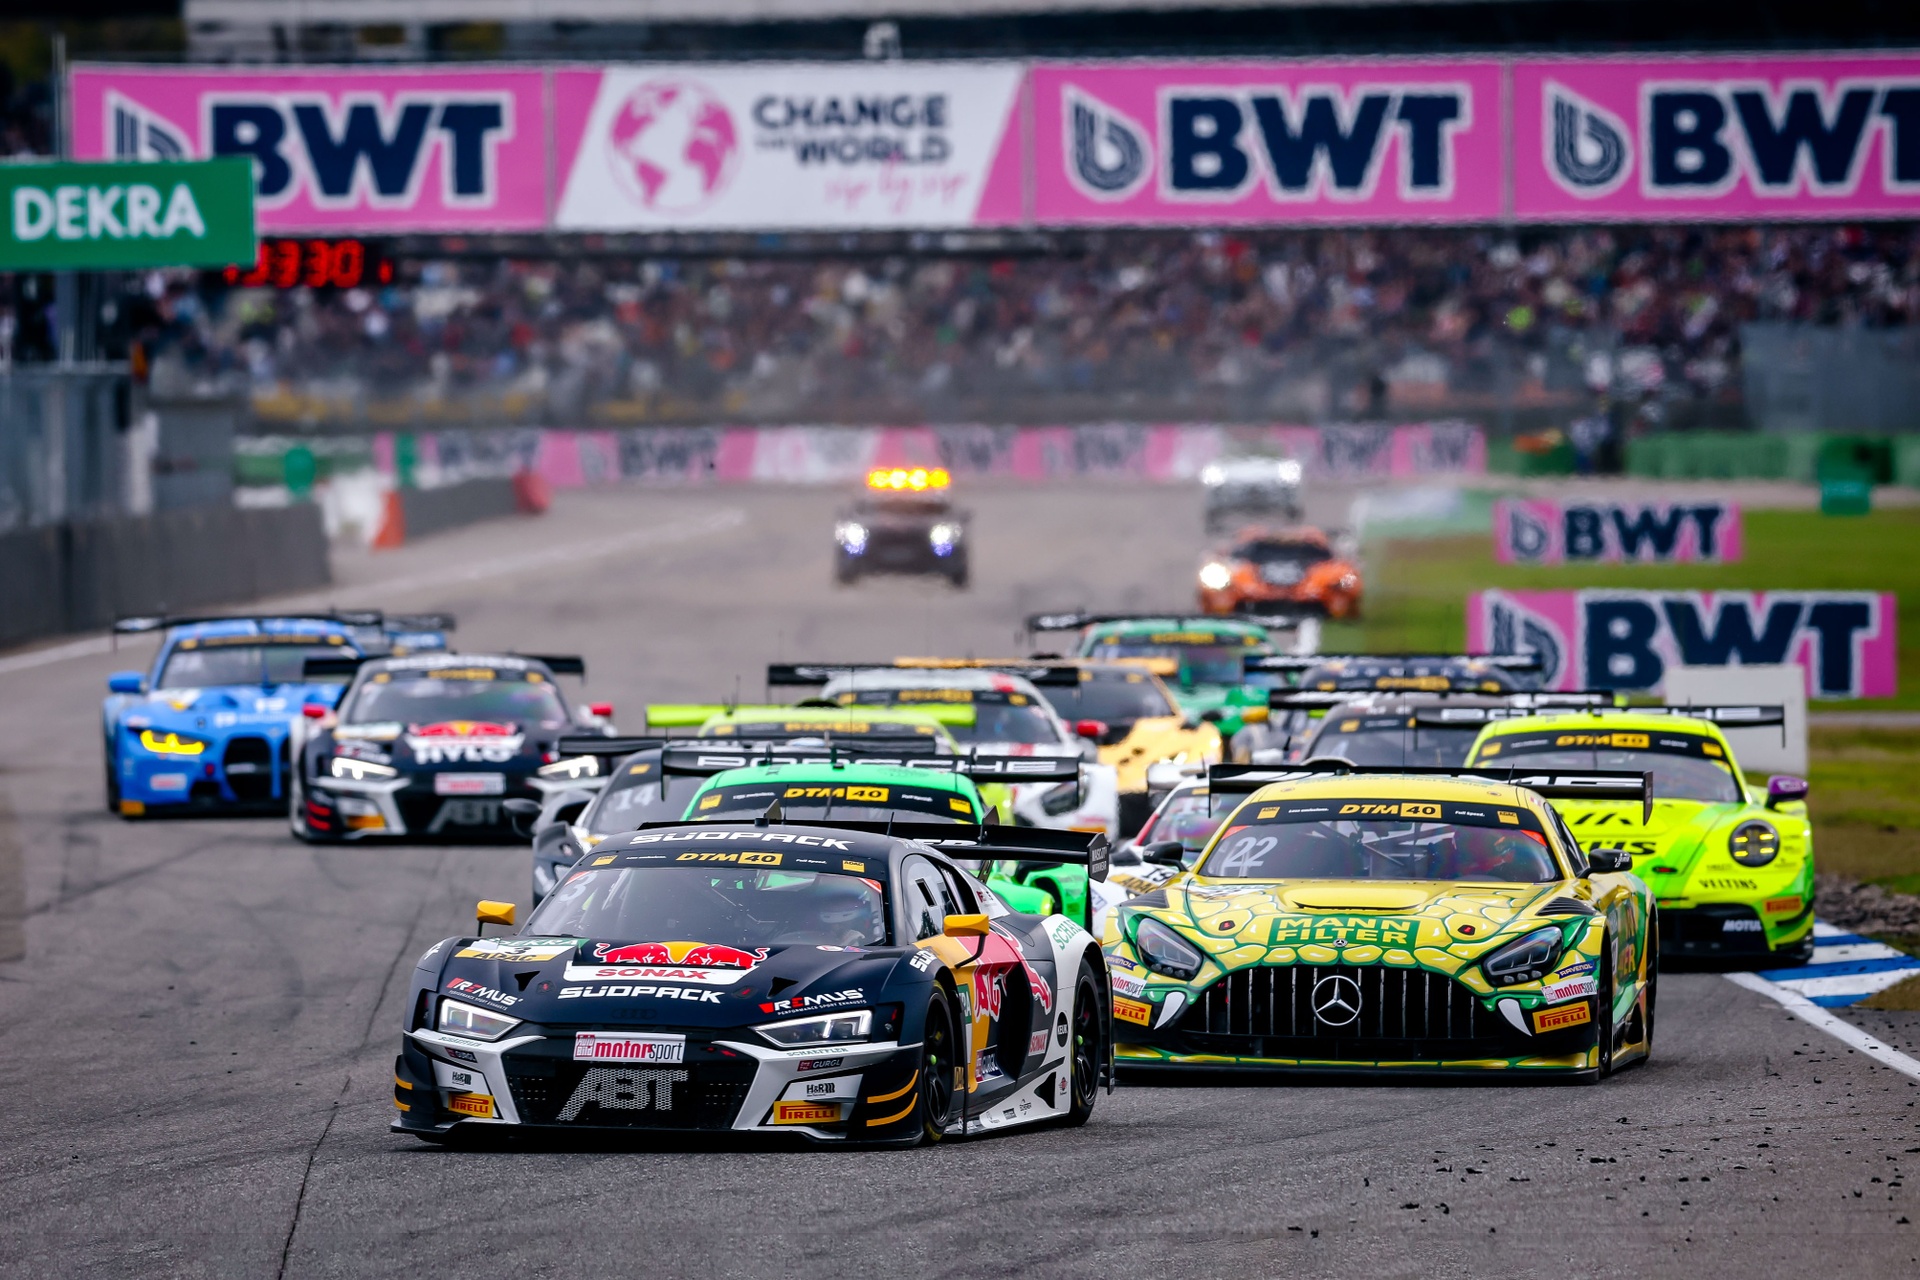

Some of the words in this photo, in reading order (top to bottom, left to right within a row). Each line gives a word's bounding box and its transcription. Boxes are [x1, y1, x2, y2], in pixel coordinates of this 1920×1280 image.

[752, 95, 946, 129] CHANGE
[211, 103, 502, 196] BWT
[796, 136, 951, 165] WORLD
[1171, 95, 1461, 191] BWT
[12, 185, 205, 240] DEKRA
[1565, 506, 1722, 556] BWT
[1585, 600, 1870, 692] BWT
[612, 788, 655, 812] 14
[783, 788, 845, 798] DTM
[852, 790, 882, 798] 40
[1339, 804, 1399, 815] DTM
[1406, 806, 1437, 815] 40
[675, 852, 739, 862] DTM
[744, 854, 777, 863] 40
[1223, 836, 1278, 866] 22
[1700, 879, 1758, 890] VELTINS
[1279, 917, 1410, 932] MANN
[1722, 919, 1762, 931] MOTUL
[1276, 928, 1408, 944] FILTER
[595, 968, 710, 980] SONAX
[1560, 964, 1593, 976] RAVENOL
[453, 980, 519, 1006] REMUS
[774, 989, 864, 1011] REMUS
[777, 1006, 818, 1015] PERFORMANCE
[838, 999, 867, 1007] EXHAUSTS
[1539, 1006, 1587, 1028] PIRELLI
[595, 1040, 683, 1061] motorsport
[786, 1048, 849, 1057] SCHAEFFLER
[812, 1059, 841, 1069] GURGL
[556, 1068, 689, 1121] ABT
[806, 1083, 824, 1094] H&R
[452, 1096, 490, 1114] PIRELLI
[780, 1104, 836, 1120] PIRELLI
